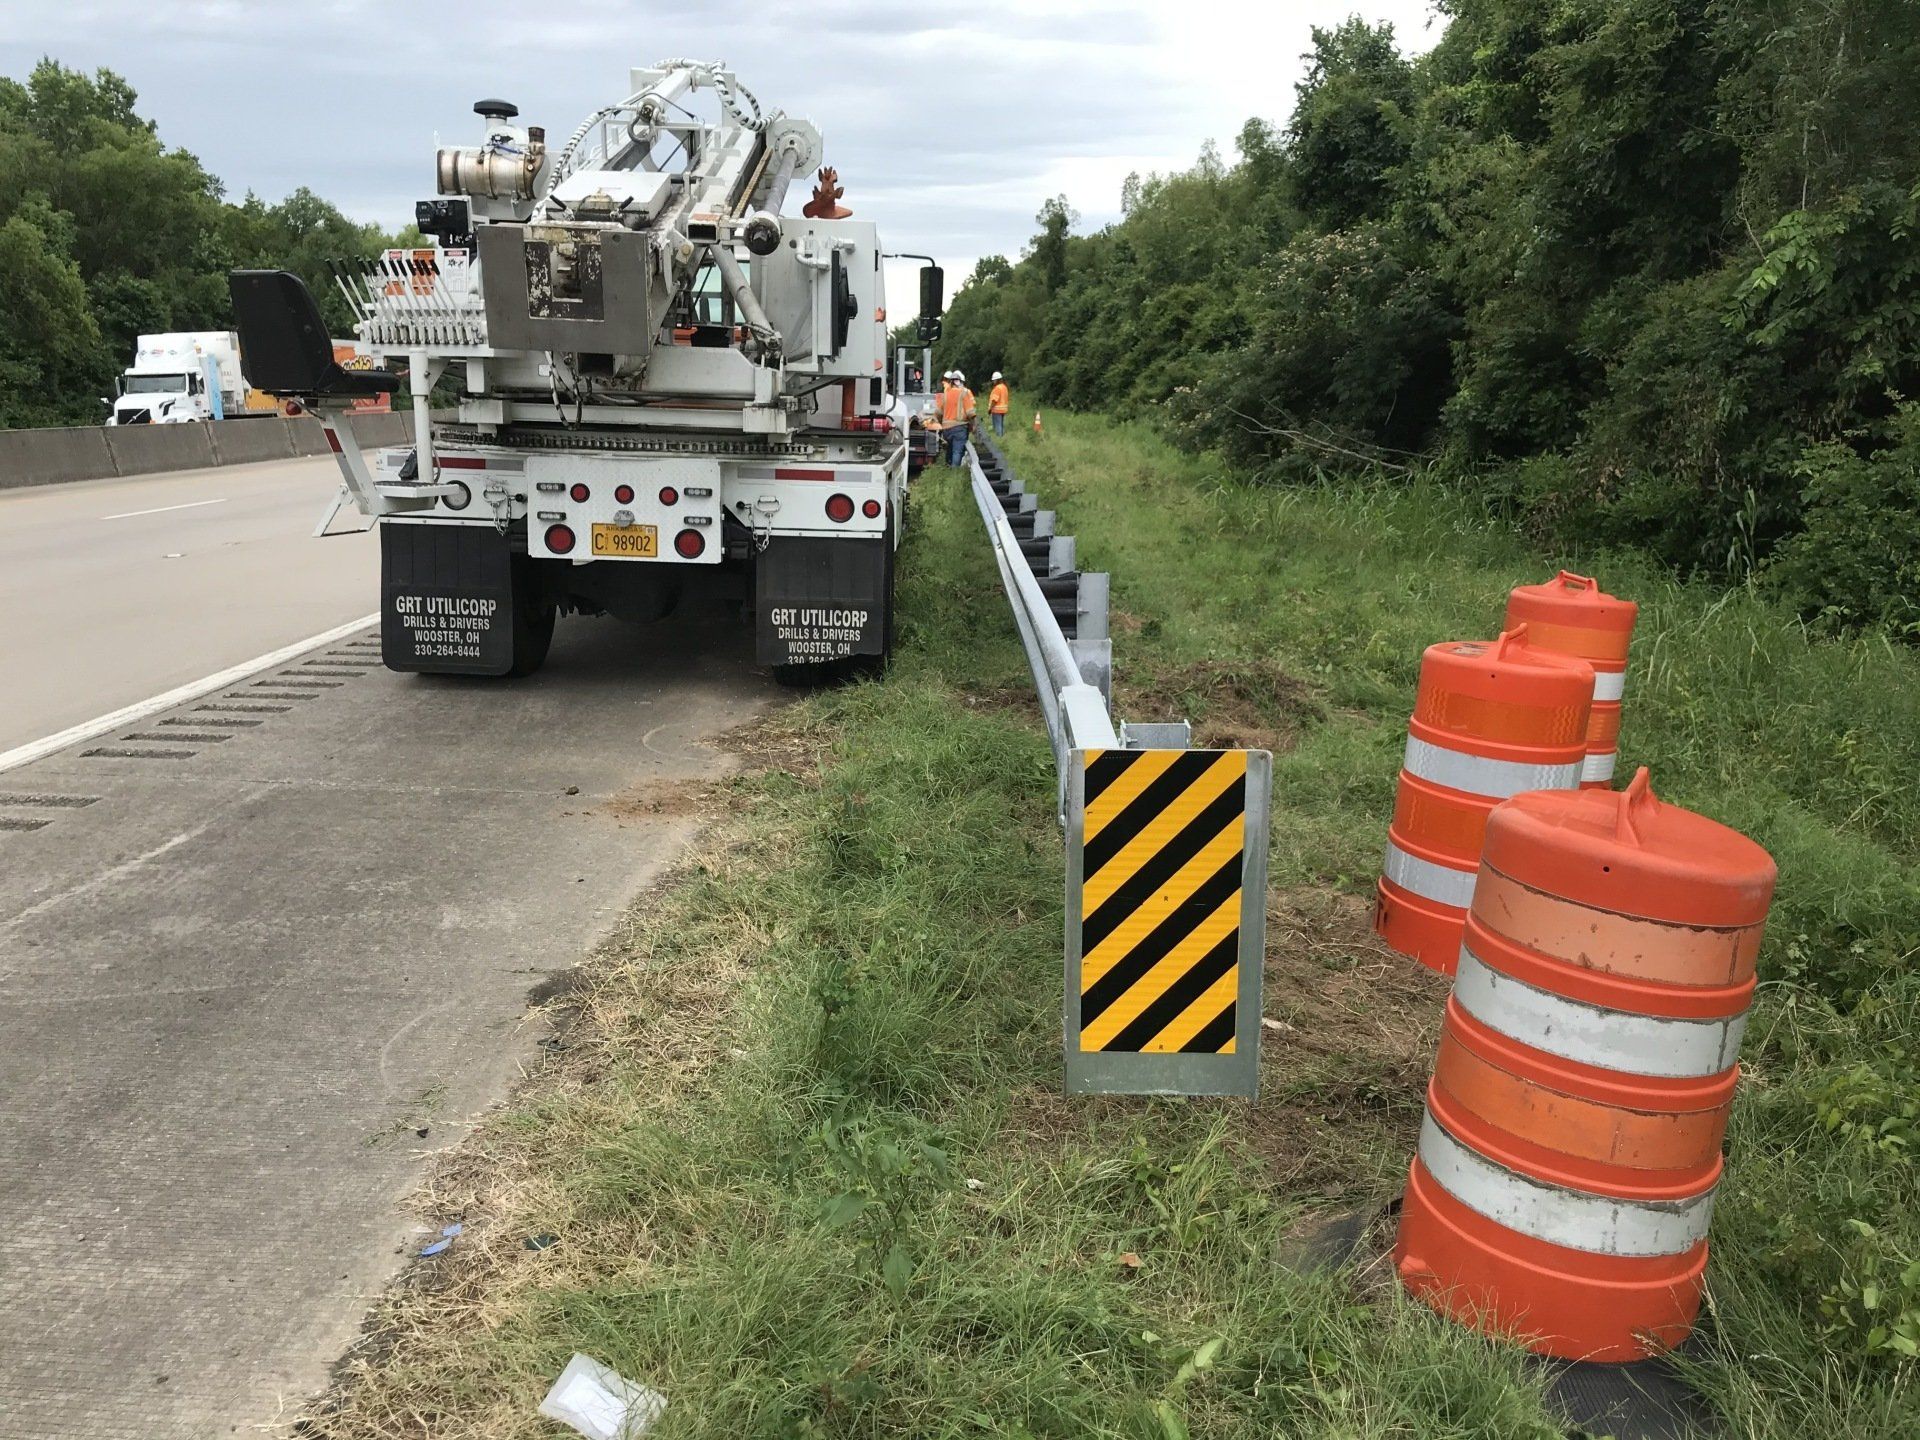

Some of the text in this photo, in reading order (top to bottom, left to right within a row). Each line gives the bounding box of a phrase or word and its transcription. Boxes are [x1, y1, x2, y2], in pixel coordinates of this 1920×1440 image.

[595, 533, 604, 550] C
[613, 535, 651, 552] 98902
[396, 595, 497, 616] GRT UTILICORP
[403, 615, 490, 630] DRILLS & DRIVERS
[771, 608, 868, 627] GRT UTILICORP
[414, 630, 480, 644] WOOSTER, OH
[778, 627, 861, 641] DRILLS & DRIVERS
[414, 644, 480, 657] 330-264-8444
[788, 641, 851, 655] WOOSTER, OH
